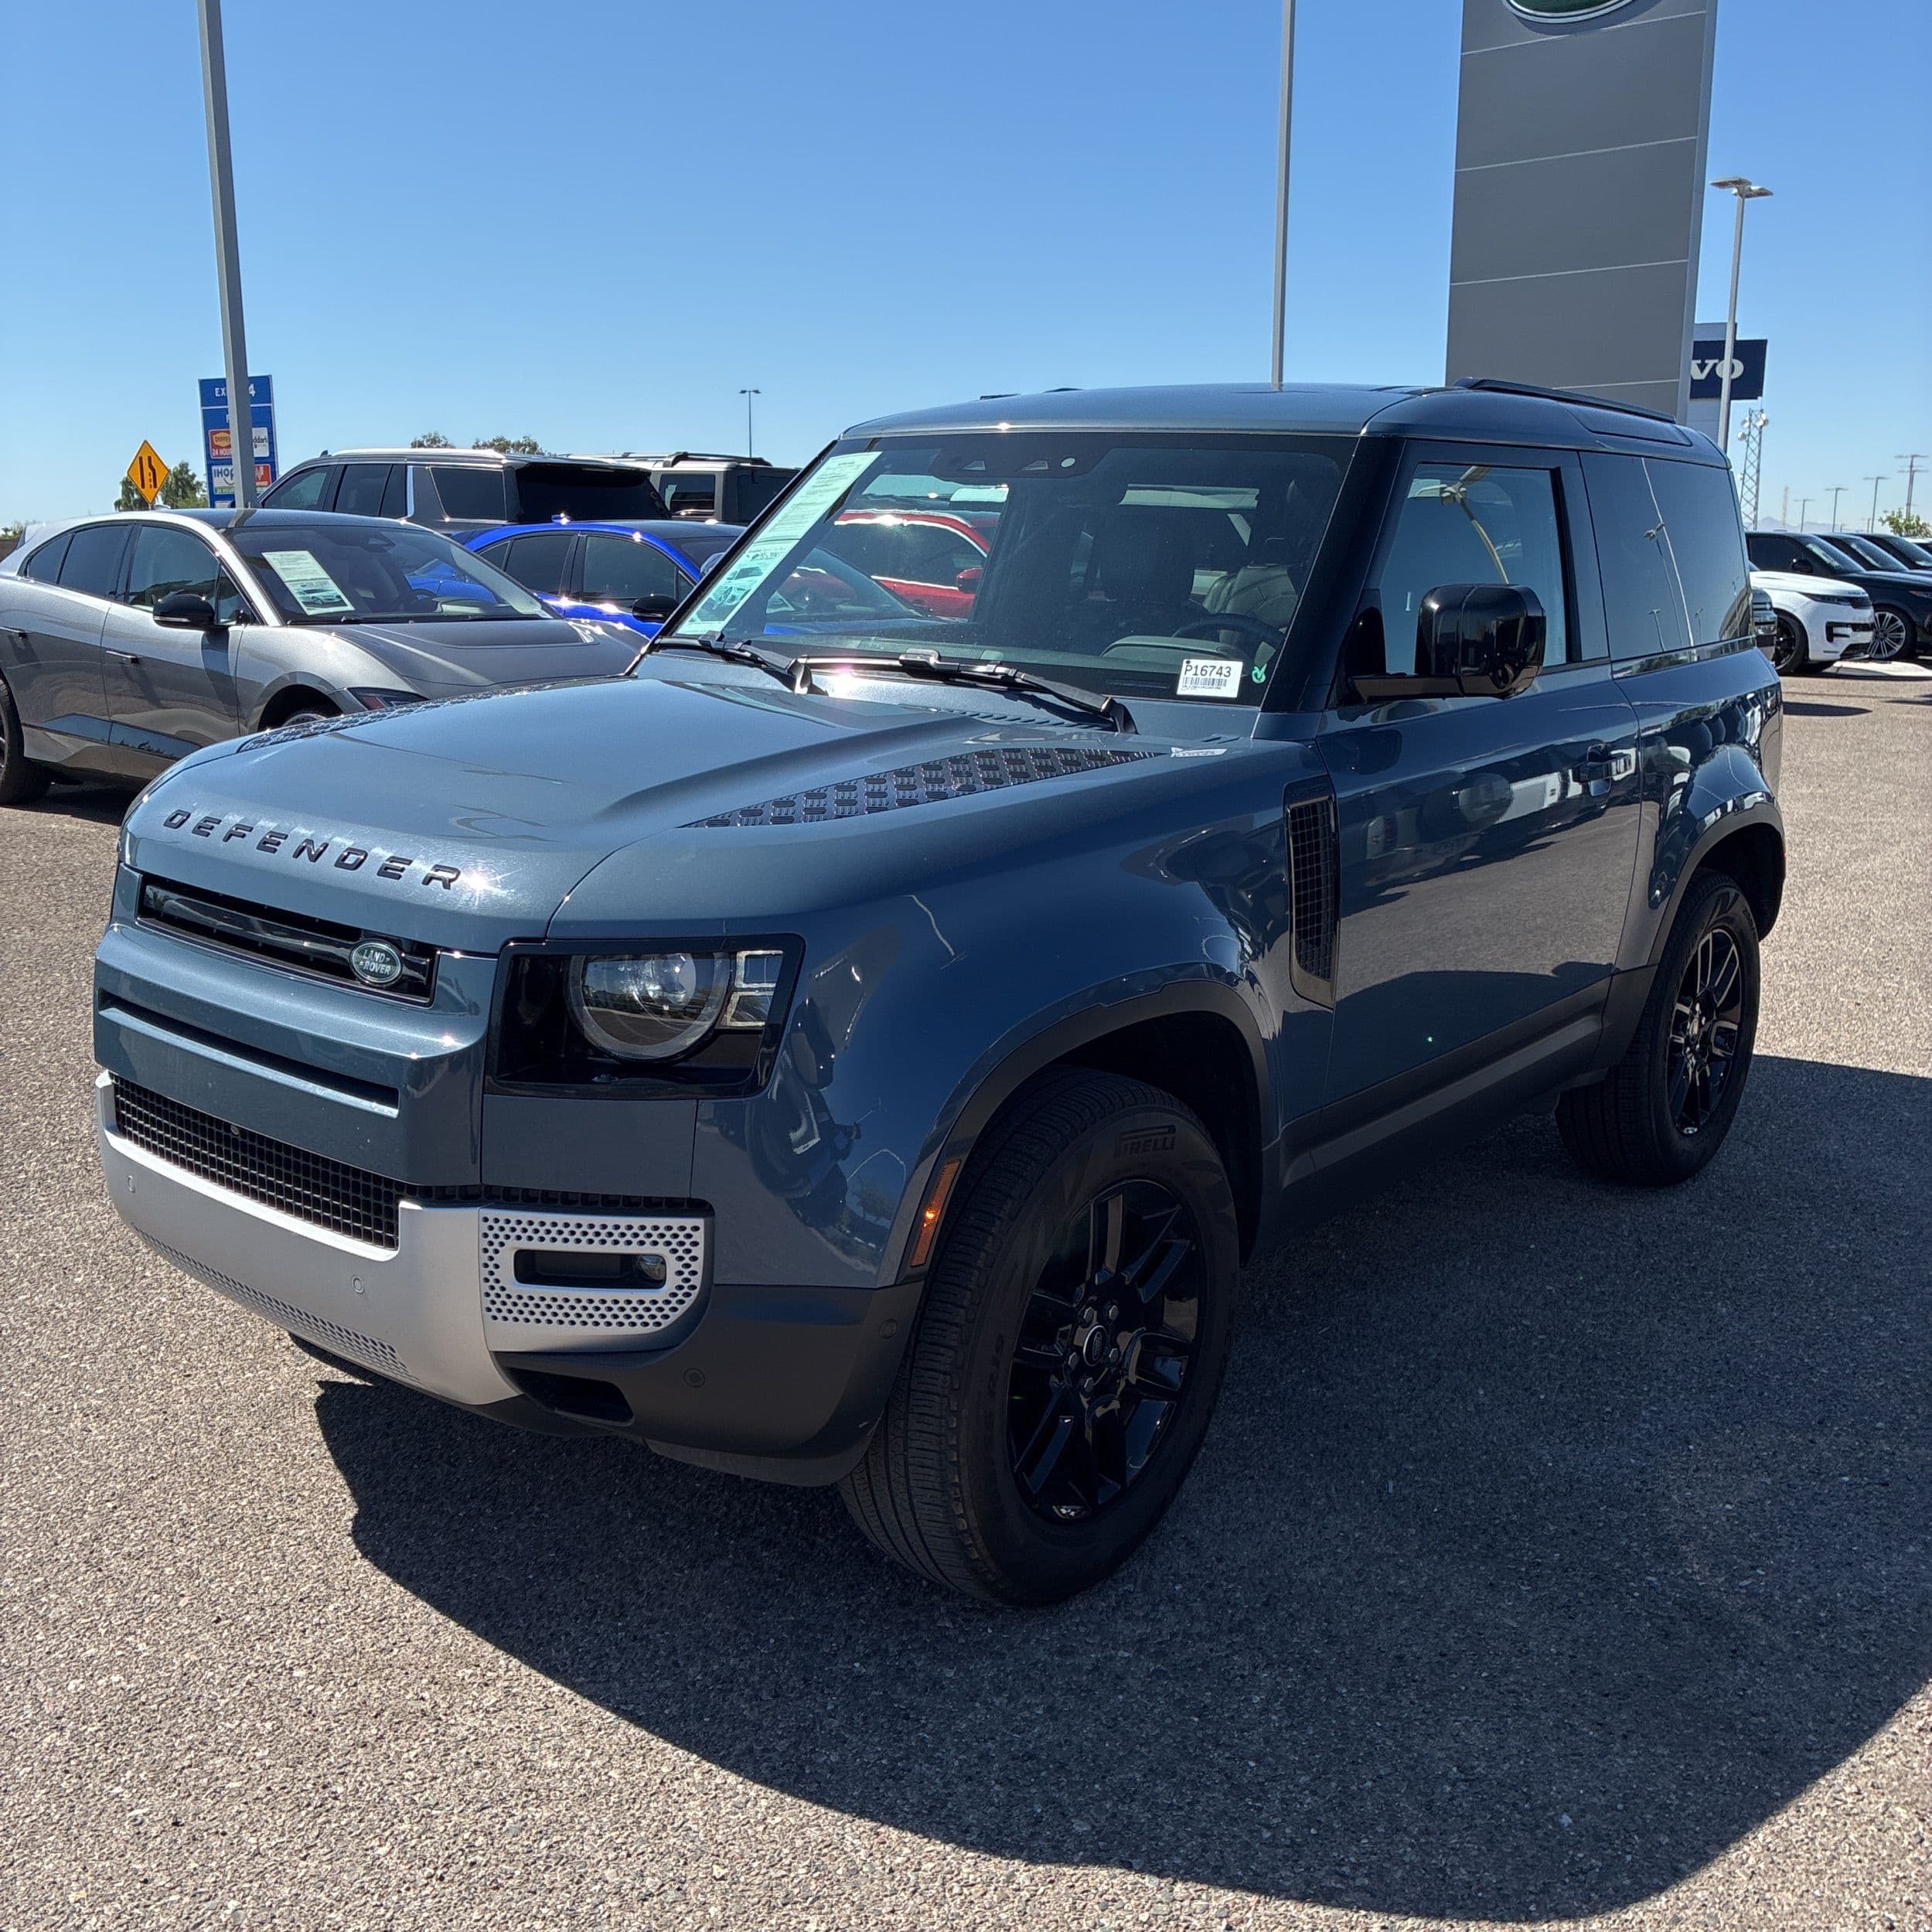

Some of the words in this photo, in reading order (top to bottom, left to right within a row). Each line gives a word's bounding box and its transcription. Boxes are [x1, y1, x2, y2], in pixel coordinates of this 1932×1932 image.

[1184, 664, 1232, 677] P16743
[162, 809, 462, 890] DEFENDER
[363, 949, 386, 963] LAND
[363, 960, 391, 976] ROVER
[1114, 1125, 1176, 1157] PIRELLI
